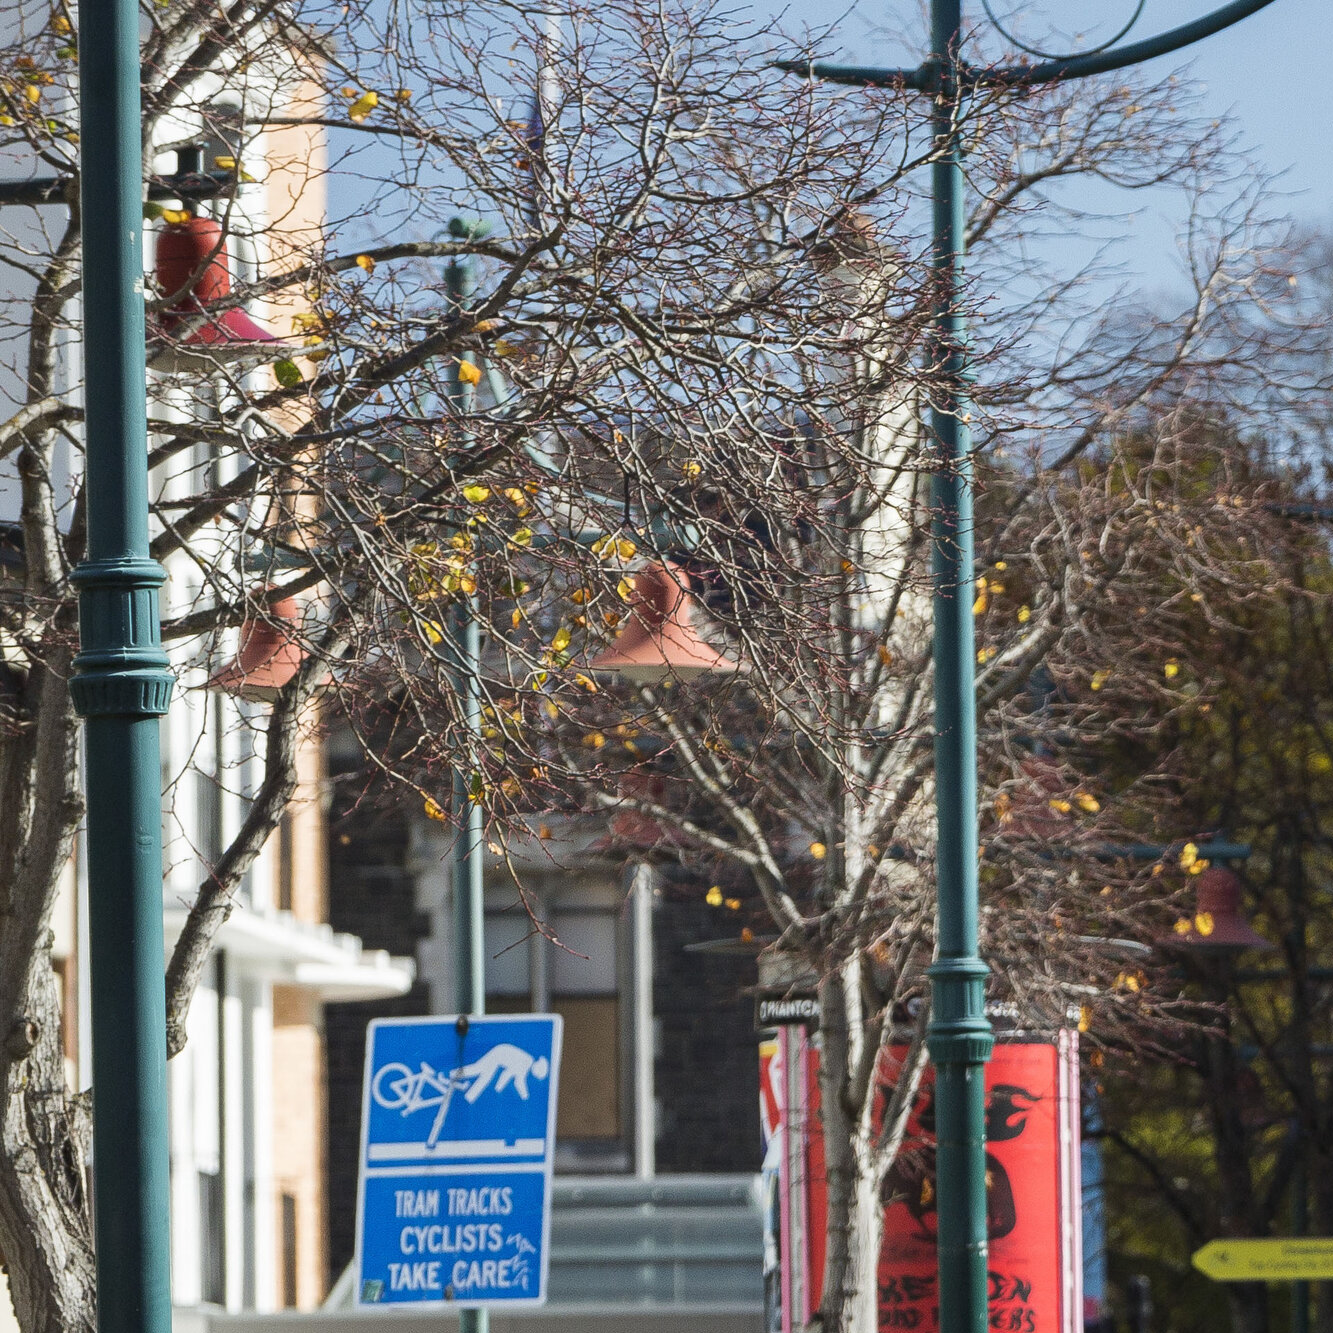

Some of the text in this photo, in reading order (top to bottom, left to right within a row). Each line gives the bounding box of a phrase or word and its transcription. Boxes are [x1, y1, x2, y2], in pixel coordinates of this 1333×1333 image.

[395, 1186, 513, 1217] TRAM TRACKS
[400, 1223, 504, 1255] CYCLISTS
[388, 1261, 441, 1291] TAKE
[452, 1259, 512, 1289] CARE
